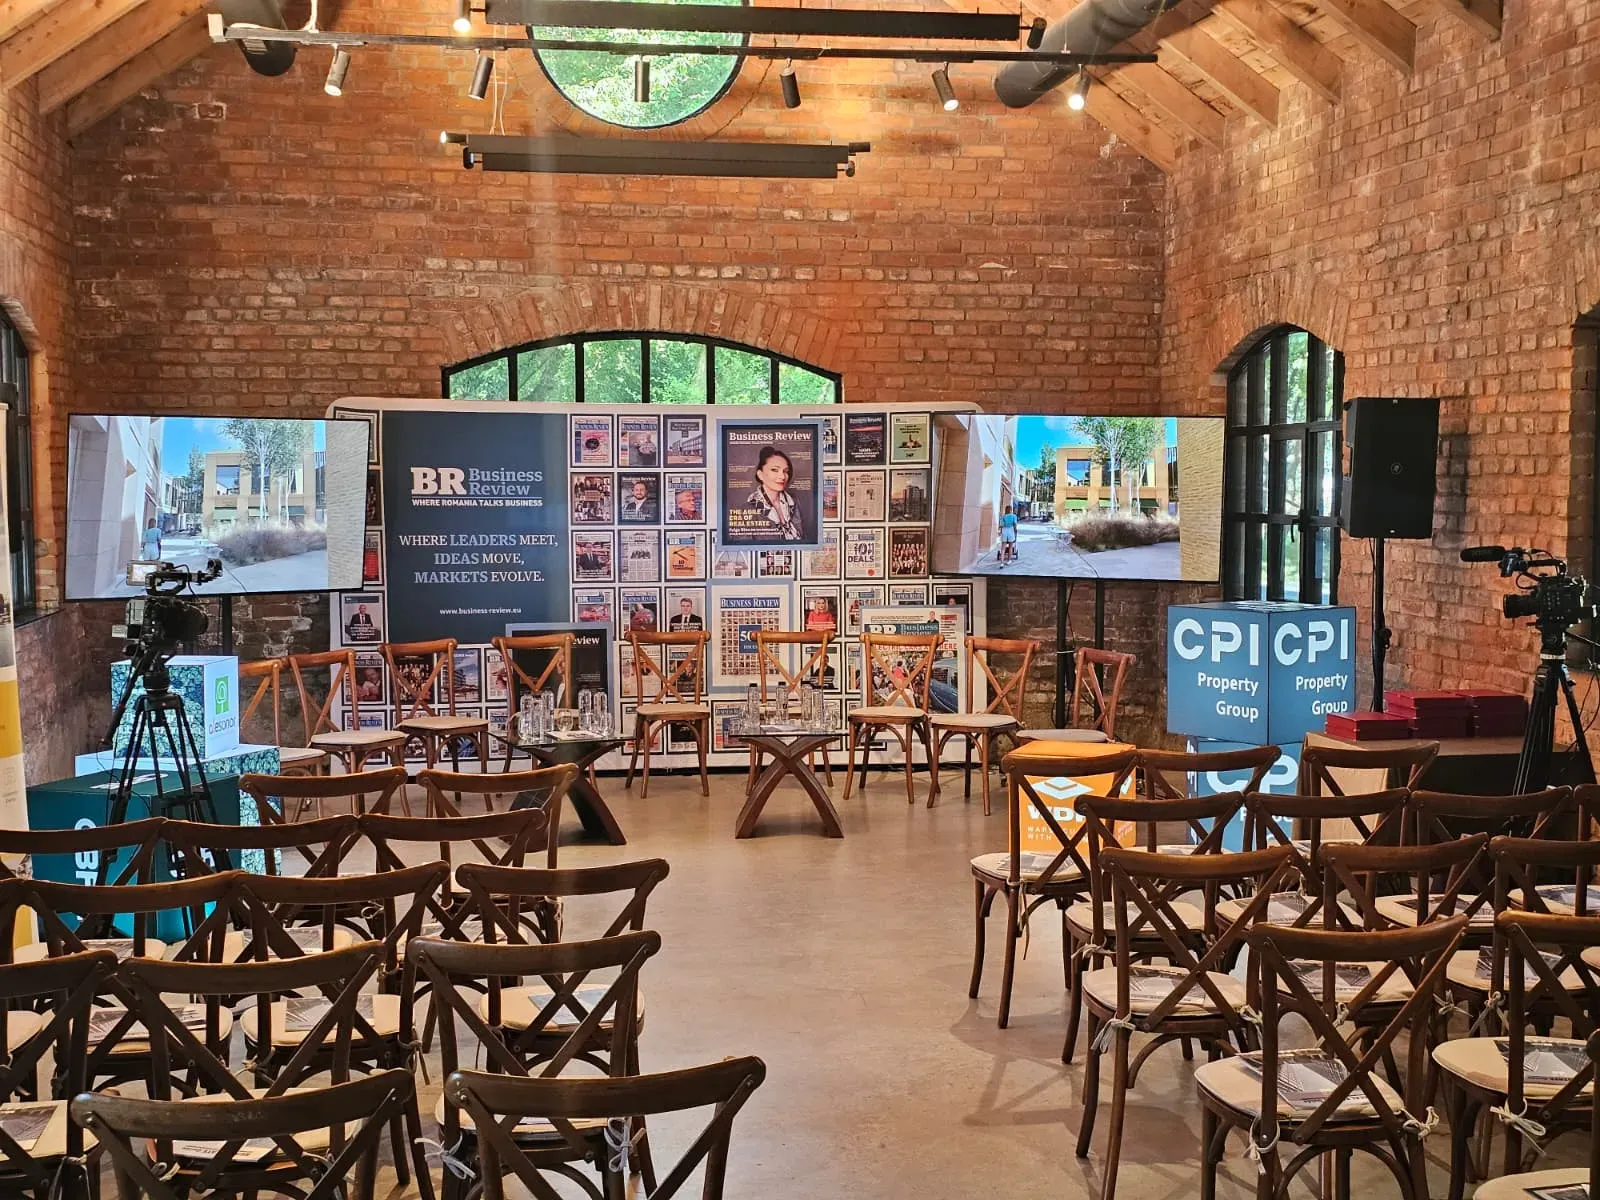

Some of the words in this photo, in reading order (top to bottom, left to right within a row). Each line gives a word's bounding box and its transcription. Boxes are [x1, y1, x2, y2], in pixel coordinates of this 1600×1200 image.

[728, 432, 774, 440] Business
[774, 432, 811, 440] Review
[410, 467, 467, 495] BR
[469, 468, 542, 482] Business
[469, 482, 530, 496] Review
[399, 536, 448, 546] WHERE
[450, 535, 516, 546] LEADERS
[519, 534, 558, 546] MEET,
[434, 553, 479, 564] IDEAS
[482, 553, 524, 565] MOVE,
[414, 572, 488, 584] MARKETS
[490, 571, 544, 582] EVOLVE.
[722, 598, 752, 608] BUSINESS
[753, 598, 779, 608] REVIEW
[572, 635, 600, 644] view
[1174, 618, 1258, 666] CPI
[1274, 619, 1348, 666] CPI
[1198, 672, 1258, 696] Property
[1296, 674, 1348, 692] Property
[1216, 700, 1258, 722] Group
[1312, 700, 1348, 714] Group
[1206, 754, 1299, 794] CP
[1028, 805, 1086, 822] WD
